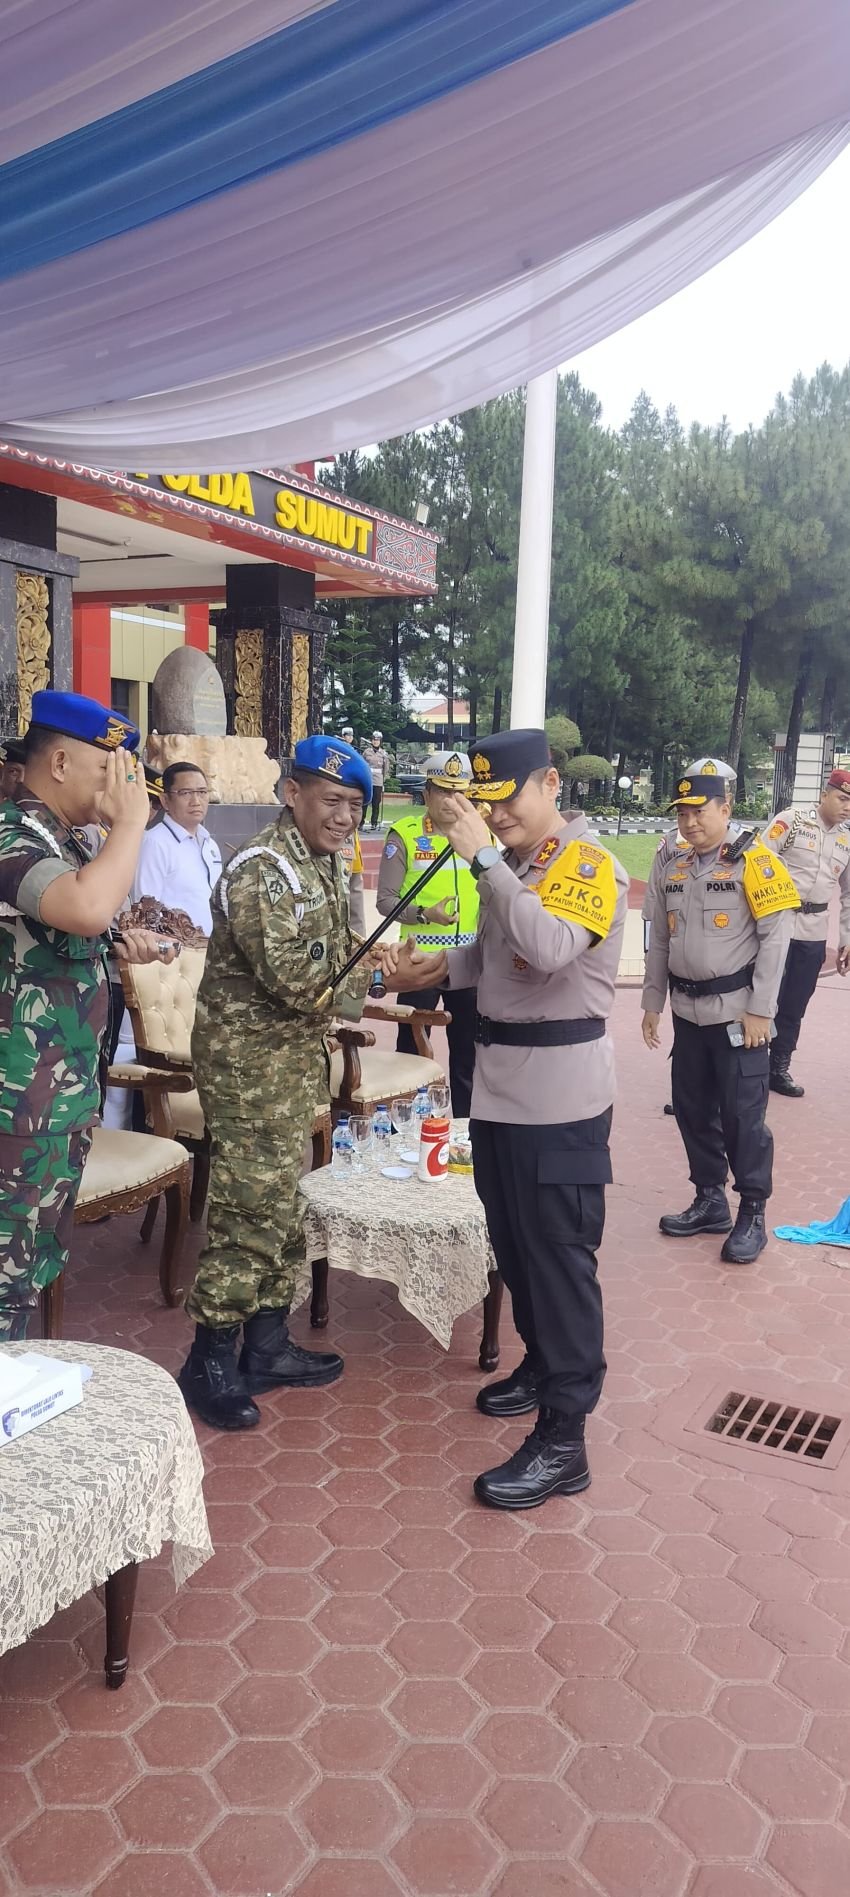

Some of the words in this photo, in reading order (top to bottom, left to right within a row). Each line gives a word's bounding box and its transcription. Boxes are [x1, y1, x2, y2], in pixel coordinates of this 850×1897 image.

[275, 490, 373, 555] SUMUT
[798, 829, 817, 840] BAGUS
[665, 884, 684, 894] FADIL
[706, 882, 736, 892] POLRI
[752, 885, 777, 901] WAKIL
